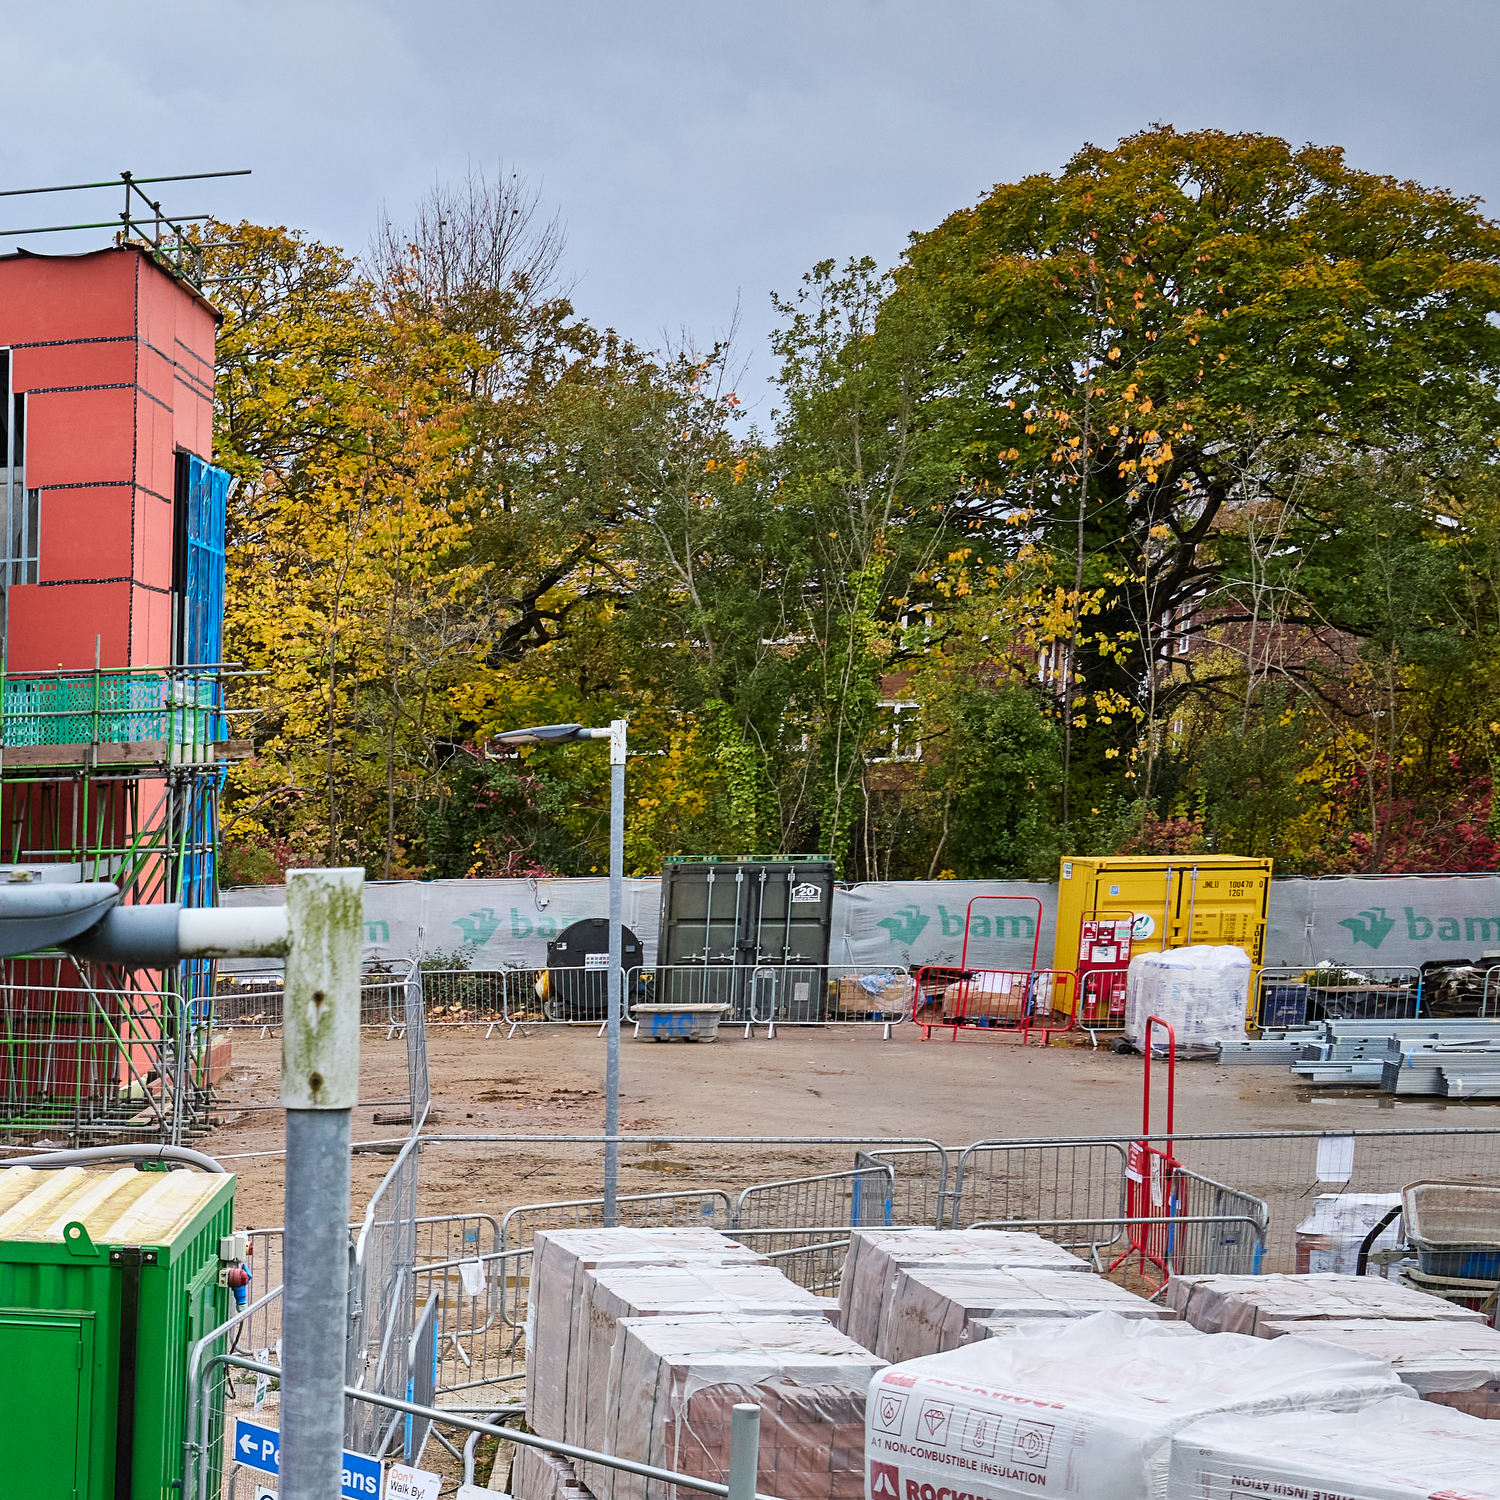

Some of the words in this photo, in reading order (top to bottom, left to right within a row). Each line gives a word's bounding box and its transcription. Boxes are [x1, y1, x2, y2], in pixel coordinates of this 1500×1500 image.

[799, 888, 815, 896] 20
[937, 905, 1035, 938] bam
[1403, 907, 1500, 941] bam
[871, 1437, 881, 1448] A1
[884, 1439, 977, 1471] NON-COMBUSTIBLE
[980, 1463, 1047, 1486] INSULATION
[391, 1469, 414, 1484] Don't
[390, 1481, 409, 1495] Walk
[411, 1487, 426, 1500] By!
